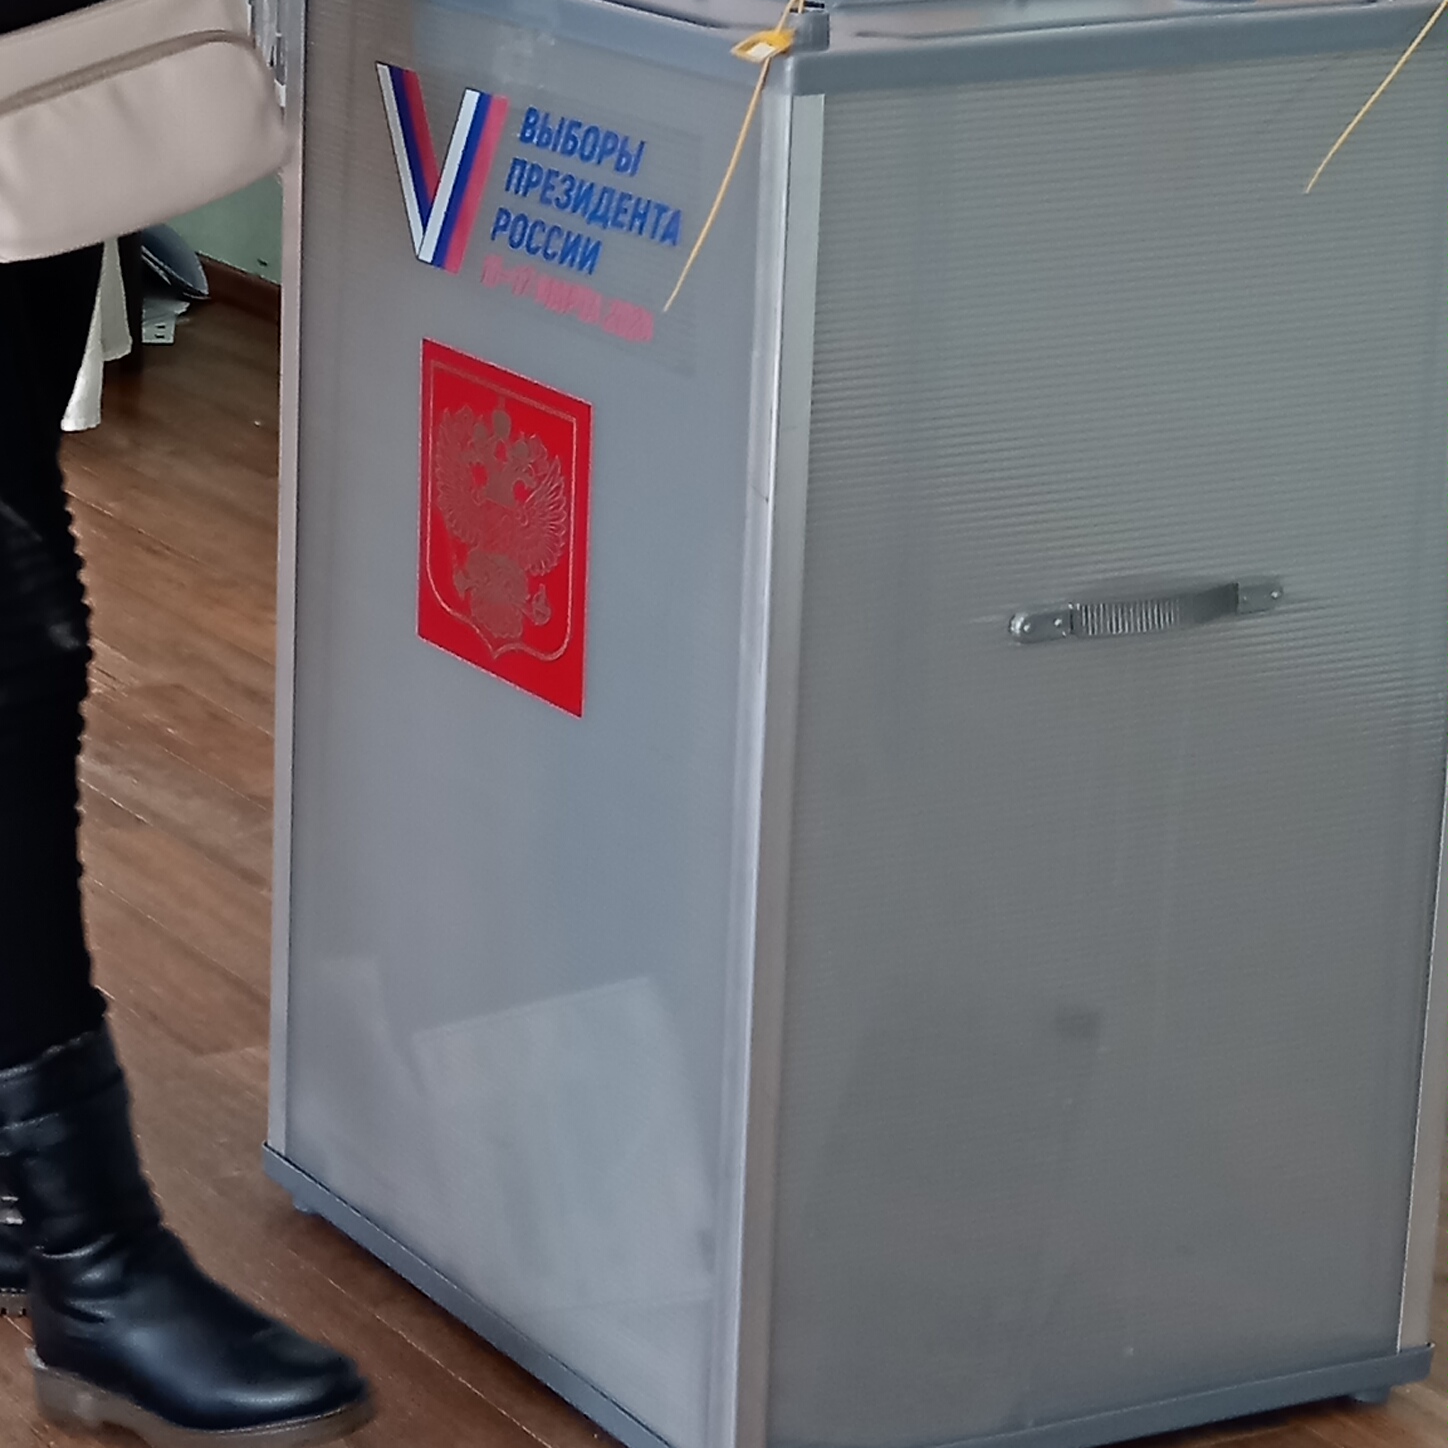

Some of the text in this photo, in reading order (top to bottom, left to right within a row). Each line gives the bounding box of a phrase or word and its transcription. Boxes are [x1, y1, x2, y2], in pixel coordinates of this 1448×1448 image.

[518, 106, 647, 178] ВЫБОРЫ
[504, 157, 684, 246] ПРЕЗИДЕНТА
[490, 207, 603, 275] РОССИИ
